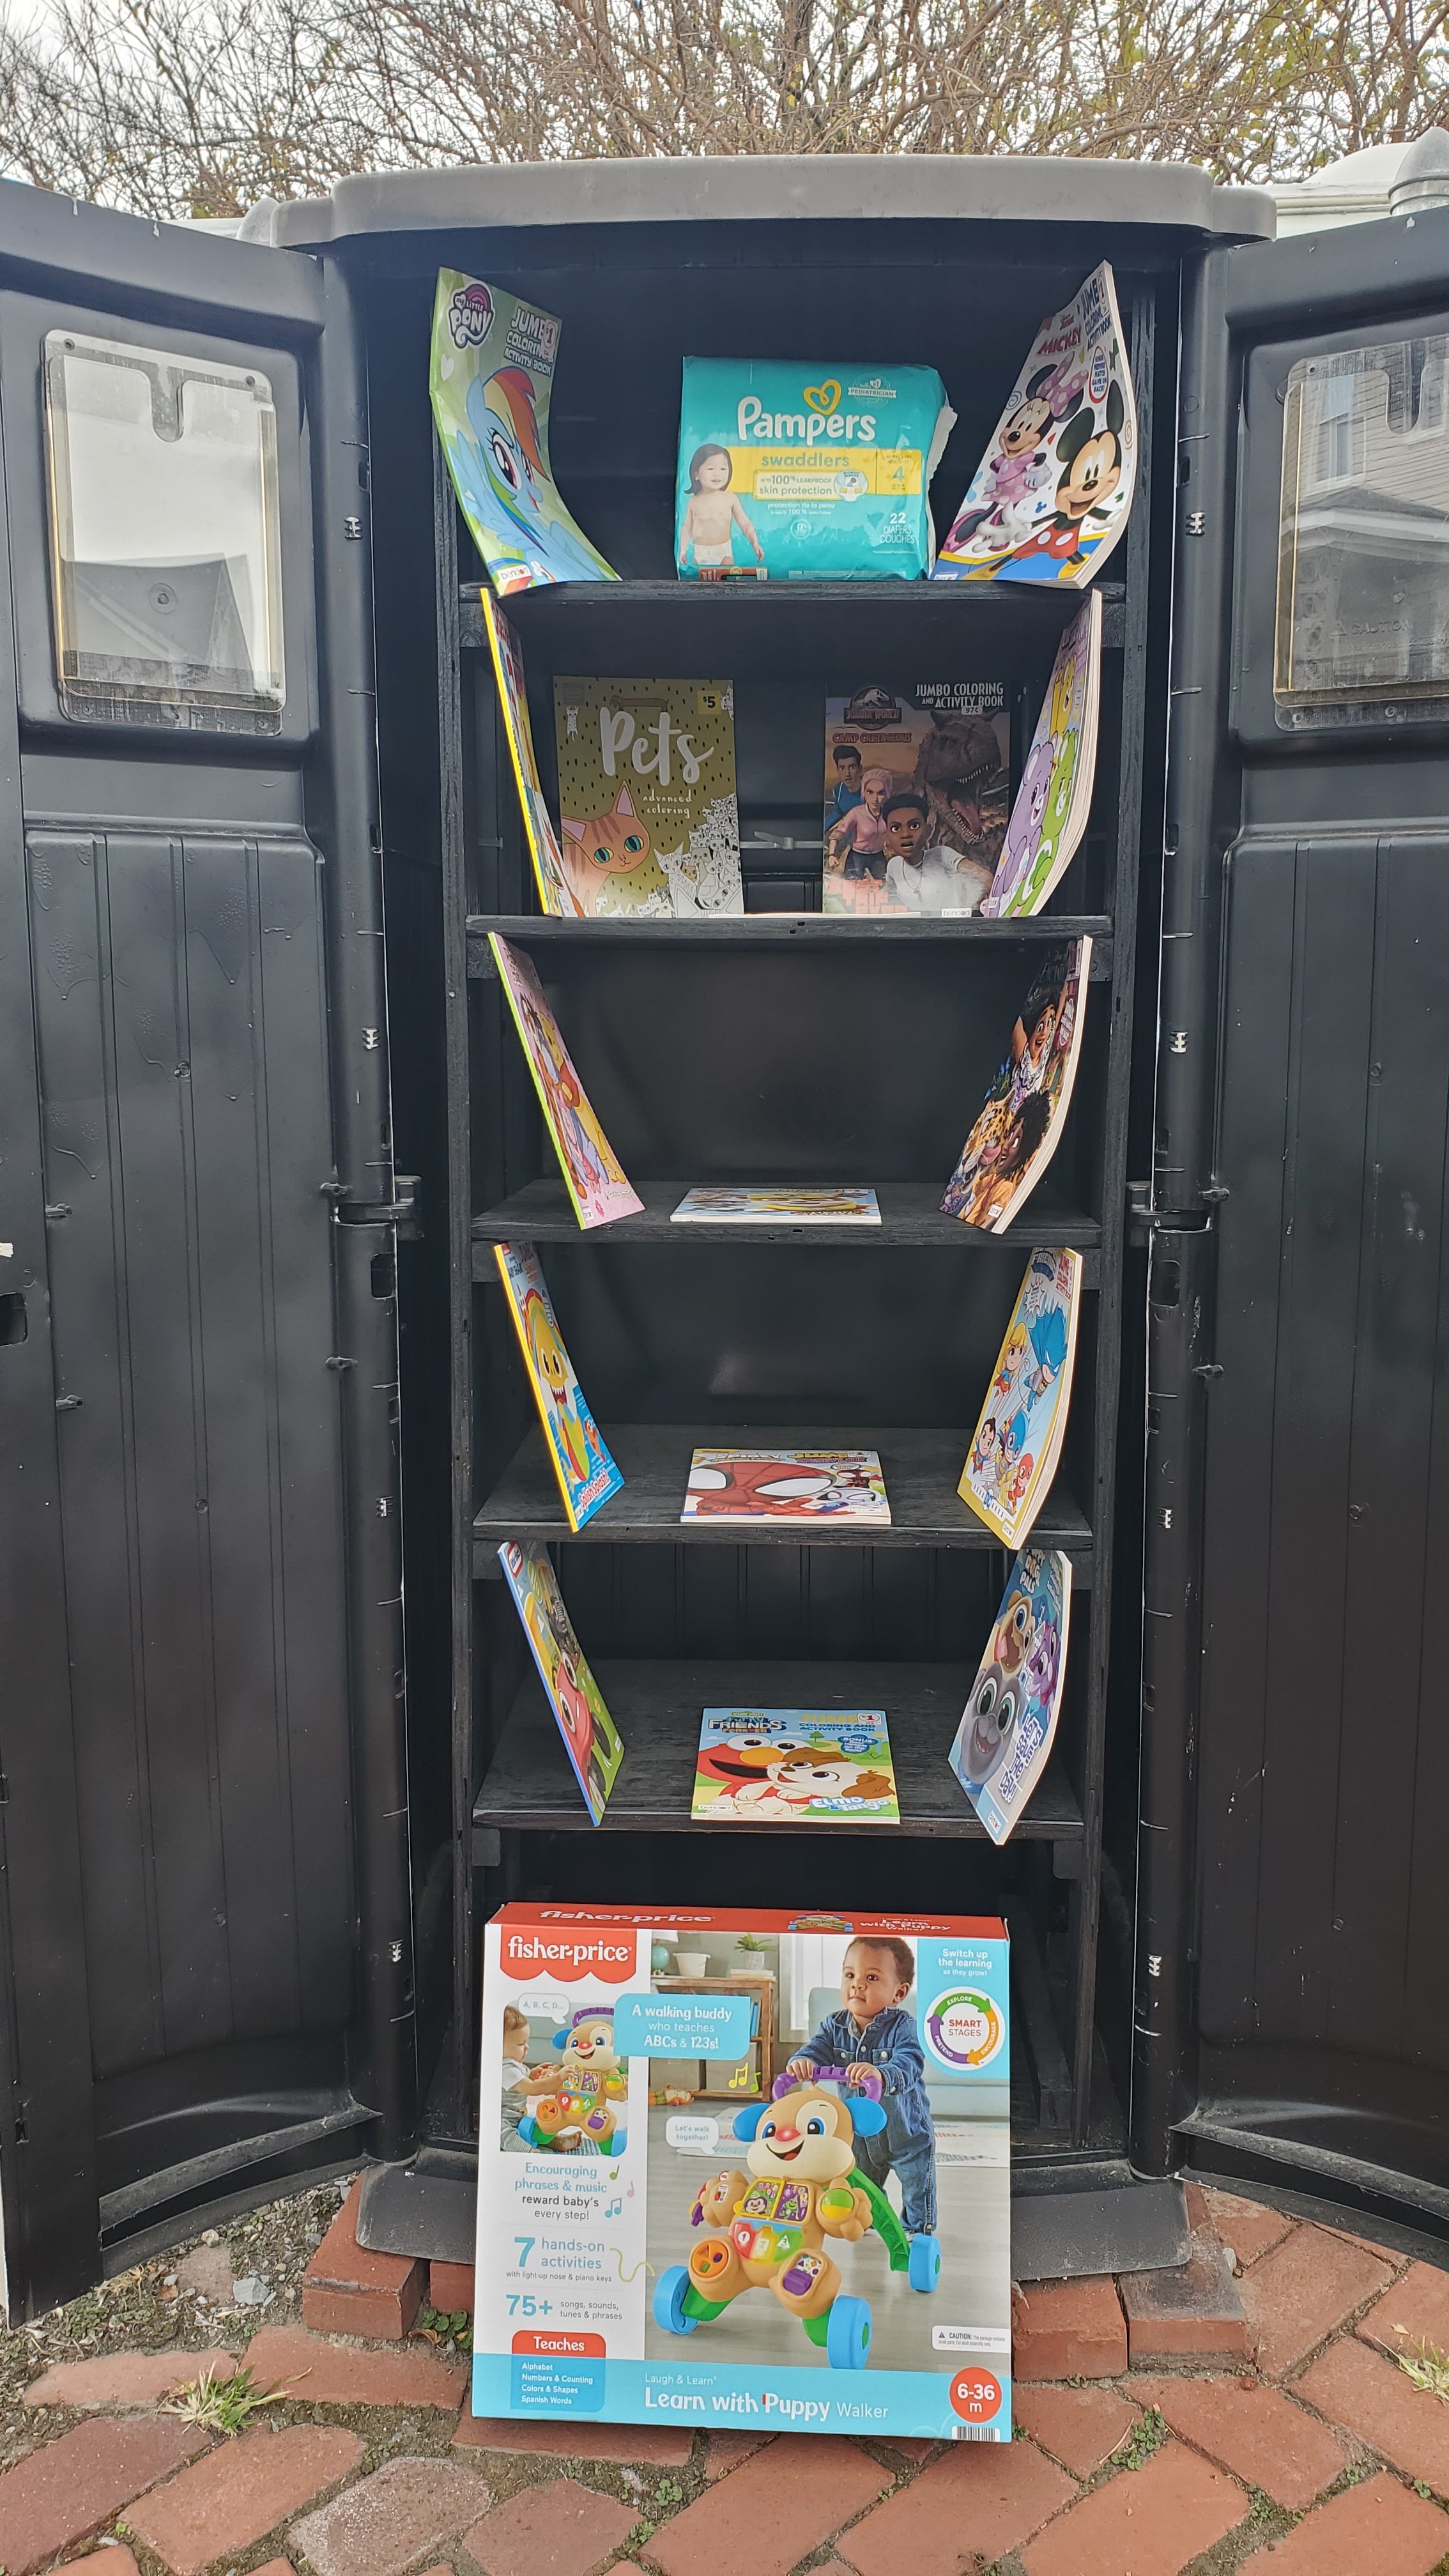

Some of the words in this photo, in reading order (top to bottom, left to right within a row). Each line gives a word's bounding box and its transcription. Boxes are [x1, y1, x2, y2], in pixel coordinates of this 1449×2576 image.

[448, 308, 494, 336] PONY
[1038, 321, 1082, 355] MICKEY
[504, 348, 532, 367] ACTIVITY
[533, 360, 552, 376] BOOK
[850, 388, 894, 397] PEDIATRICIAN
[737, 395, 876, 446] Pampers
[761, 452, 850, 467] swaddlers
[891, 466, 905, 482] 4
[759, 486, 778, 495] skin
[781, 486, 832, 496] protection
[889, 512, 906, 525] 22
[883, 525, 912, 535] DIAPERS
[879, 534, 915, 545] COUCHES
[916, 684, 951, 697] JUMBO
[953, 683, 1004, 696] COLORING
[703, 696, 716, 709] $5
[935, 696, 976, 709] ACTIVITY
[978, 696, 1004, 707] BOOK
[832, 733, 859, 744] CAMP
[599, 707, 714, 786] Pets
[643, 788, 693, 803] advanced
[647, 804, 690, 820] coloring
[1019, 1570, 1036, 1595] PALS
[708, 1719, 784, 1730] FRIENDS
[811, 1797, 862, 1808] Elmo
[839, 1799, 890, 1812] Tango
[539, 1910, 712, 1923] fisher-price
[507, 1935, 629, 1966] fisher-price
[942, 1949, 973, 1958] Switch
[976, 1951, 988, 1959] up
[956, 1958, 992, 1969] learning
[946, 1995, 972, 2005] EXPLORE
[632, 2004, 641, 2016] A
[645, 2005, 691, 2021] walking
[694, 2006, 732, 2022] buddy
[648, 2021, 670, 2030] who
[674, 2022, 715, 2032] teaches
[949, 2019, 982, 2027] SMART
[644, 2035, 677, 2048] ABCs
[680, 2038, 687, 2048] &
[691, 2036, 719, 2049] 123s!
[980, 2021, 997, 2055] ENCOURAGE
[934, 2035, 954, 2058] PRETEND
[525, 2162, 598, 2180] Encouraging
[515, 2177, 559, 2191] phrases
[562, 2180, 572, 2191] &
[575, 2182, 607, 2193] music
[522, 2195, 560, 2205] reward
[564, 2196, 599, 2209] baby's
[534, 2210, 561, 2221] every
[565, 2211, 590, 2221] step!
[542, 2237, 604, 2252] hands-on
[514, 2236, 535, 2267] 7
[541, 2256, 602, 2269] activities
[522, 2272, 548, 2280] light-up
[506, 2294, 553, 2317] 75+
[588, 2301, 618, 2310] sounds,
[592, 2312, 623, 2320] phrases
[533, 2336, 586, 2352] Teaches
[522, 2362, 553, 2371] Alphabet
[522, 2373, 553, 2382] Numbers
[562, 2375, 594, 2385] Counting
[645, 2373, 673, 2385] Laugh
[677, 2374, 684, 2384] &
[687, 2375, 714, 2386] Learn
[521, 2384, 544, 2393] Colors
[553, 2386, 578, 2395] Shapes
[957, 2383, 995, 2400] 6-36
[521, 2395, 548, 2404] Spanish
[550, 2396, 572, 2405] Words
[645, 2386, 705, 2411] Learn
[712, 2392, 759, 2413] with
[764, 2393, 831, 2422] Puppy
[836, 2402, 889, 2418] Walker
[969, 2402, 982, 2413] m
